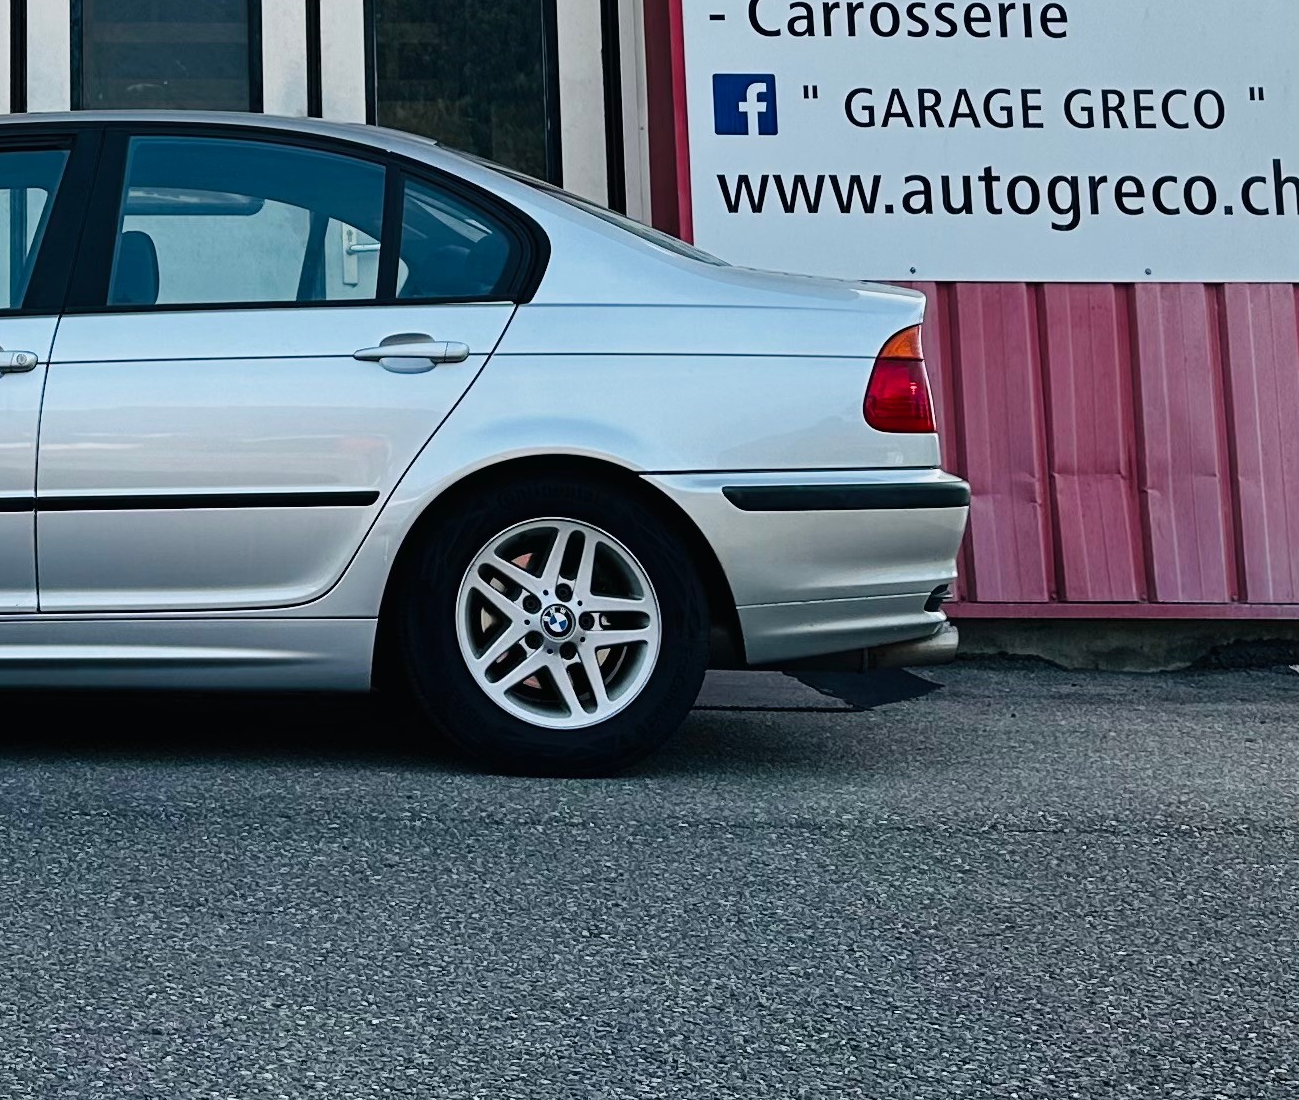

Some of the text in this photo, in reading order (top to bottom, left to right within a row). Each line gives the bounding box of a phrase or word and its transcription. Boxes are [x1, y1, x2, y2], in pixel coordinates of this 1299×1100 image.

[844, 87, 1044, 129] GARAGE
[1063, 88, 1225, 130] GRECO
[716, 158, 1299, 232] www.autogreco.ch
